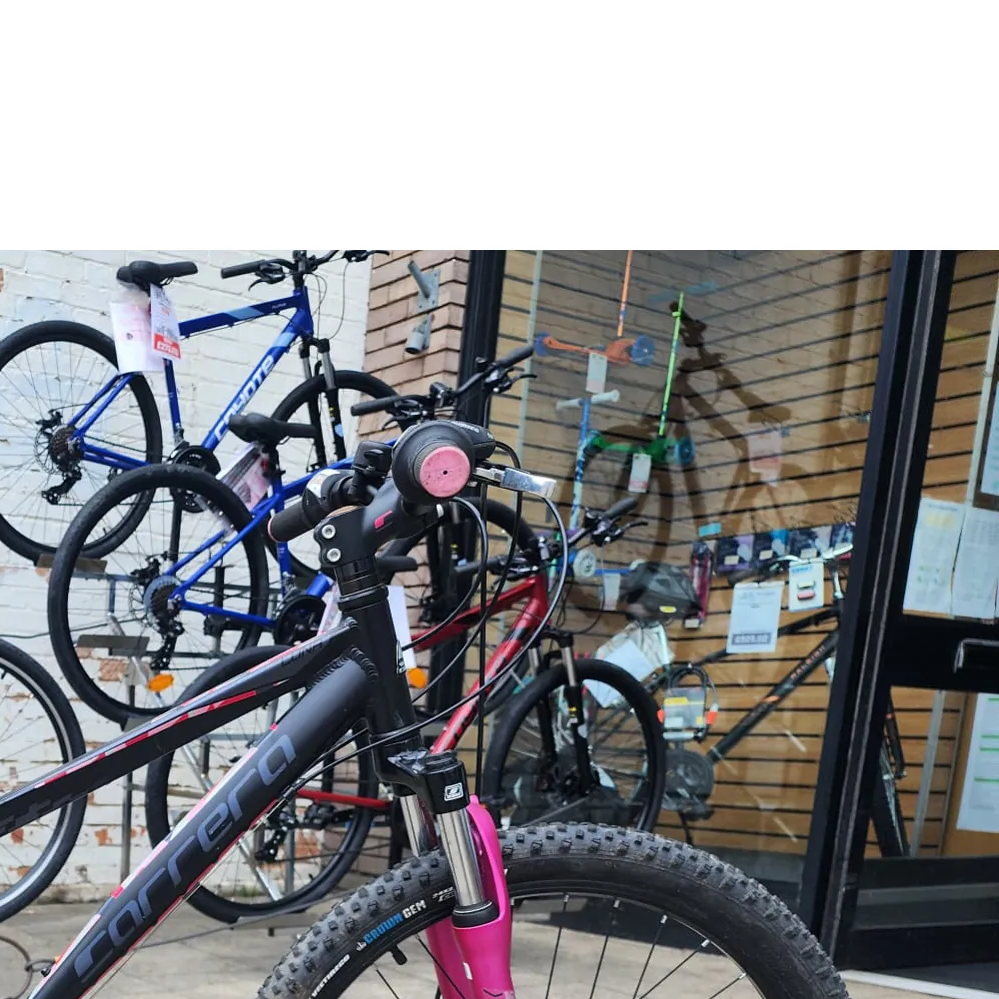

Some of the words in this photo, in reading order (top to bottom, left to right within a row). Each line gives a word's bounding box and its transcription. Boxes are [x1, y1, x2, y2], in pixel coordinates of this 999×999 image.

[73, 733, 298, 983] carrera
[363, 913, 403, 944] CROWN
[402, 900, 427, 918] GEM
